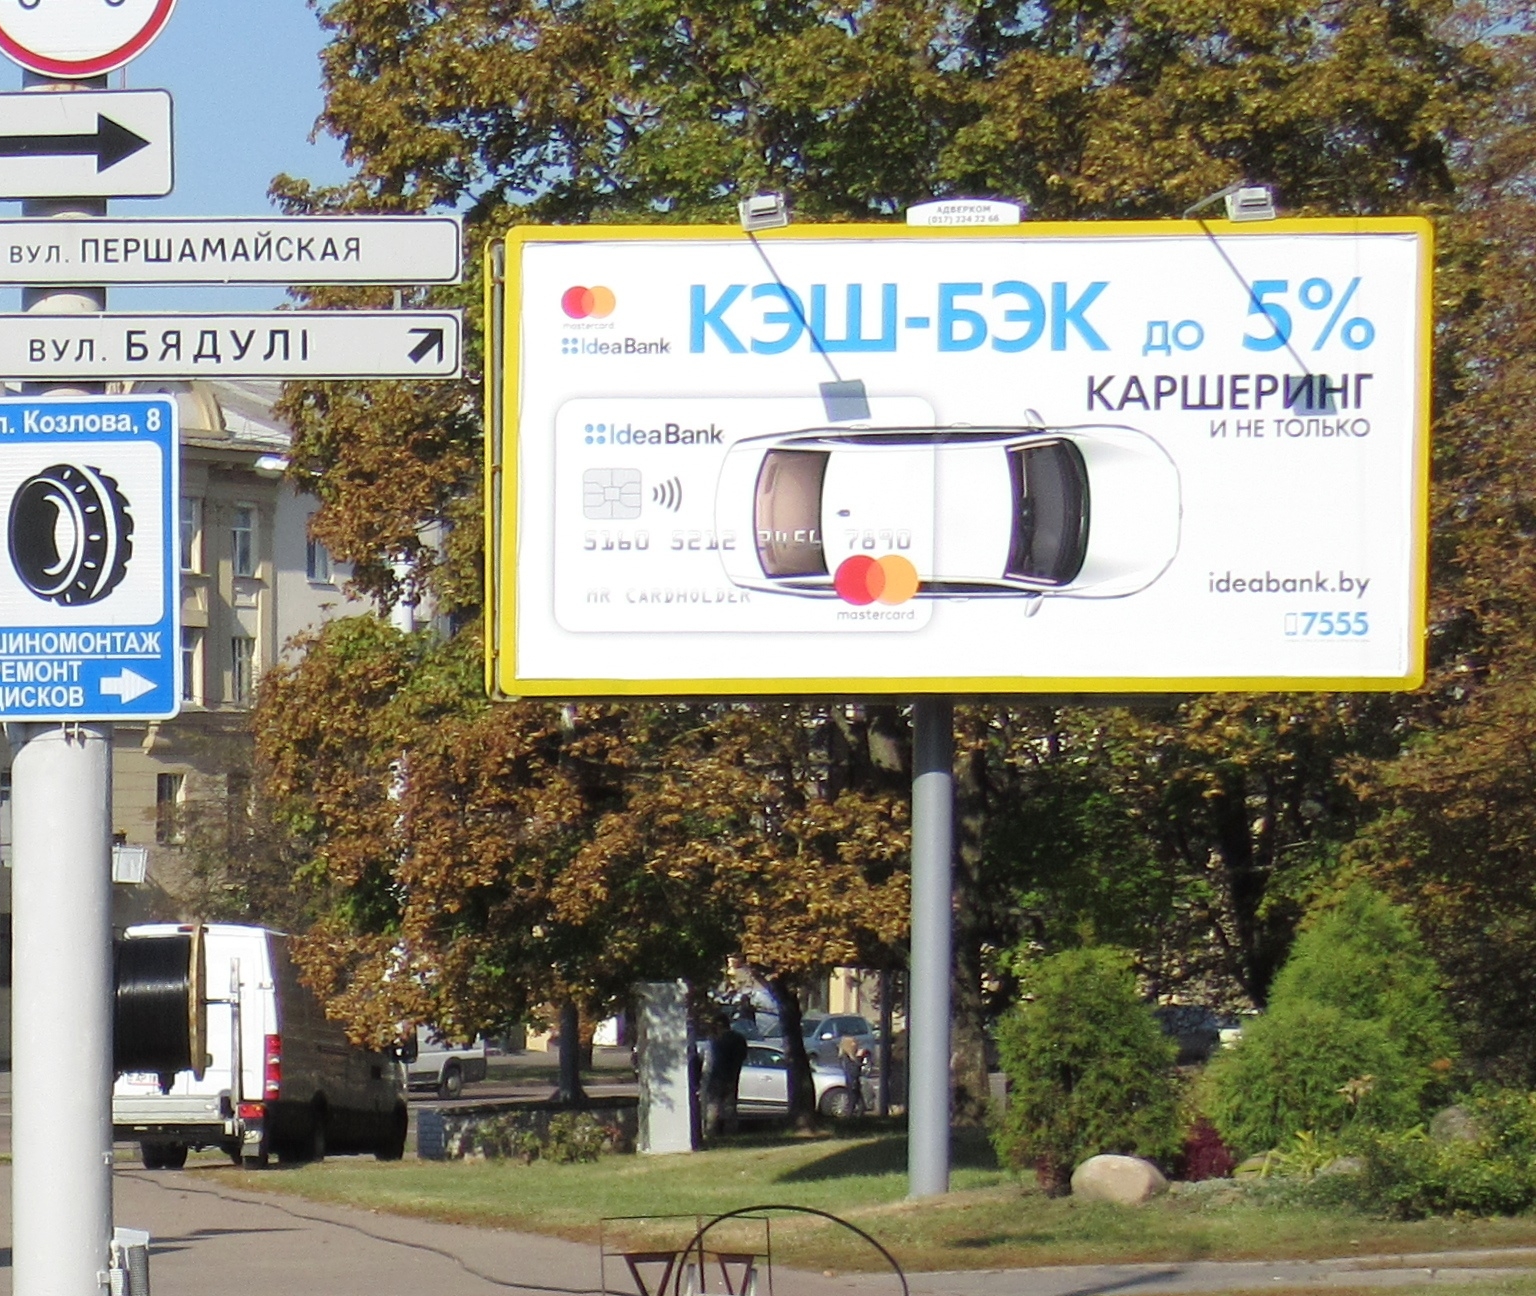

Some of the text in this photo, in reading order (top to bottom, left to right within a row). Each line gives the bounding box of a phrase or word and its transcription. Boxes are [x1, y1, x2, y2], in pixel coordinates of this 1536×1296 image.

[80, 231, 361, 264] ПЕРШАМАЙСКАЯ
[688, 280, 1112, 355] КЭШ-БЭК
[1241, 276, 1376, 352] 5%
[126, 329, 309, 364] БЯДУЛІ
[1086, 373, 1374, 411] КАРШЕРИНГ
[23, 410, 138, 434] Козлова,
[146, 407, 161, 431] 8
[1210, 418, 1371, 438] И НЕ ТОЛЬКО
[583, 530, 650, 550] 5160
[845, 529, 912, 550] 7890
[626, 587, 752, 604] CARDHOLDER
[1209, 570, 1371, 599] ideabank.by
[836, 609, 915, 620] mastercard
[1301, 611, 1369, 636] 7555
